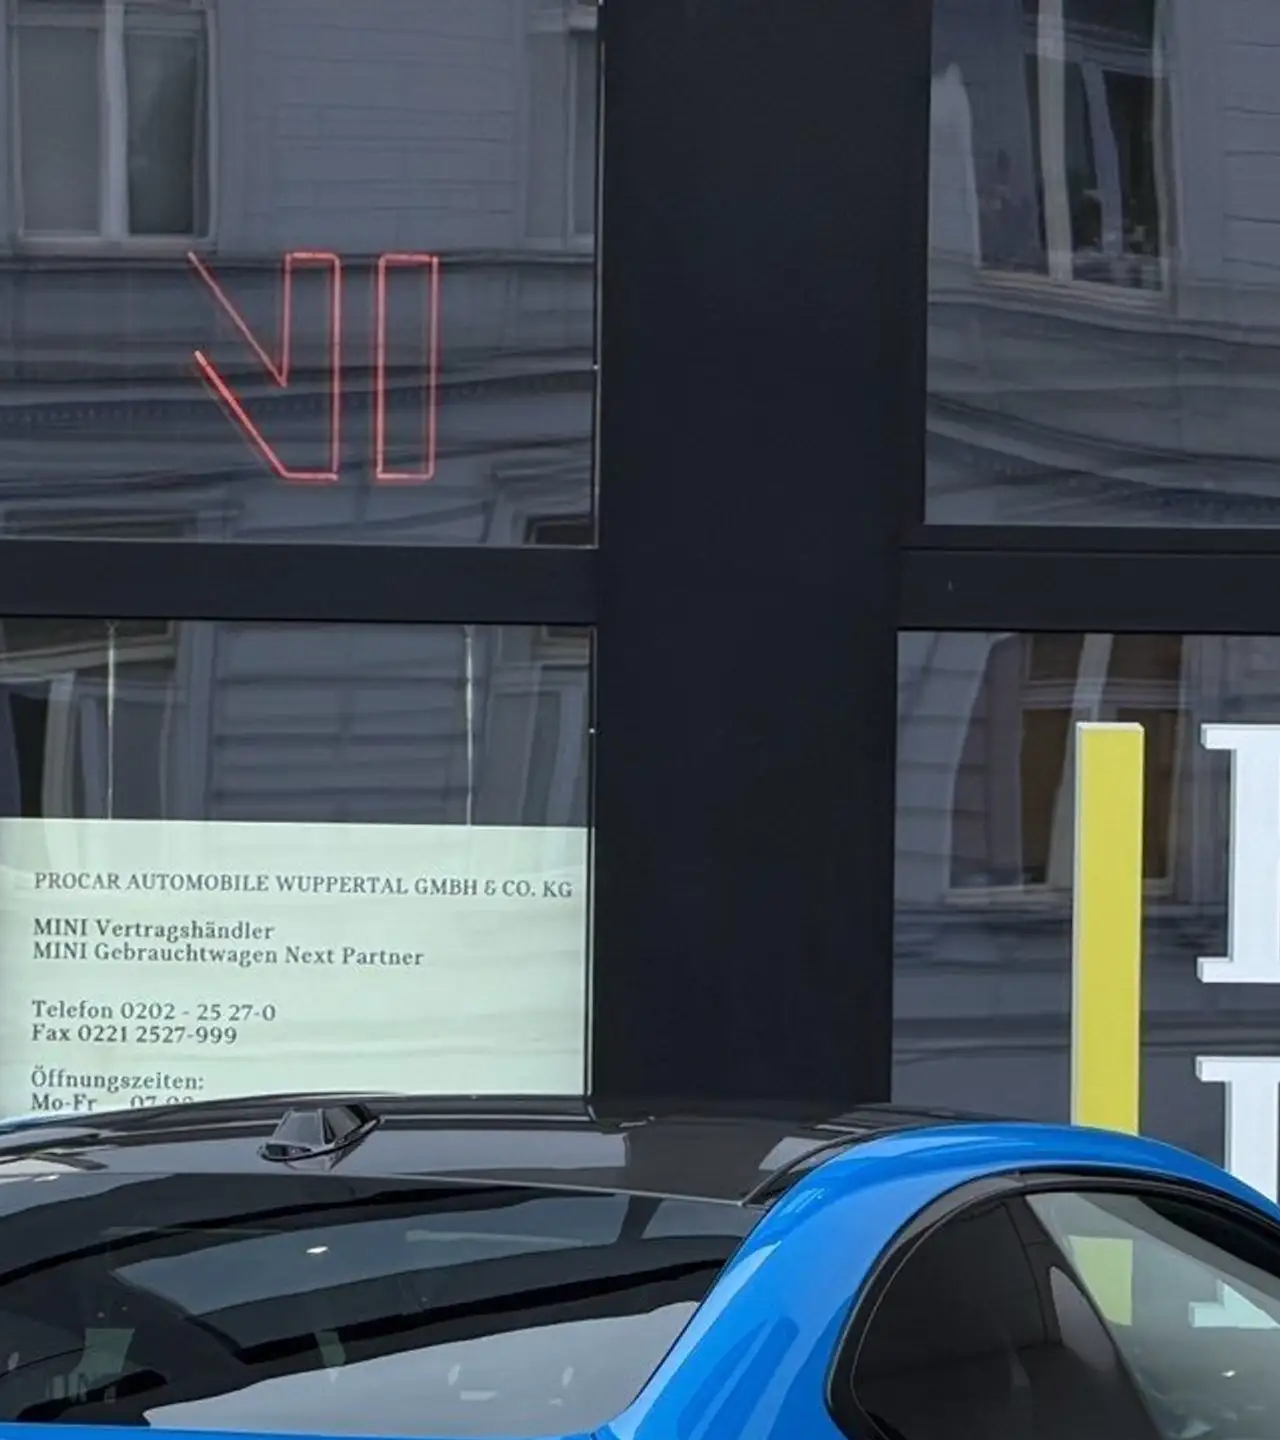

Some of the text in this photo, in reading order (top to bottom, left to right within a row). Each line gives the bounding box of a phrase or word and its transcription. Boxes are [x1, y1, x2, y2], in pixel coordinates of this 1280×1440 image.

[33, 871, 574, 899] PROCAR AUTOMOBILE WUPPERTAL GMBH & CO. KG
[32, 918, 276, 944] MINI Vertragshändler
[32, 941, 425, 968] MINI Gebrauchtwagen Next Partner
[31, 999, 113, 1019] Telefon
[119, 1001, 176, 1021] 0202
[196, 1003, 222, 1022] 25
[227, 1003, 277, 1022] 27-0
[31, 1023, 238, 1045] Fax 0221 2527-999
[30, 1064, 206, 1093] Öffnungszeiten:
[30, 1093, 98, 1112] Mo-Fr
